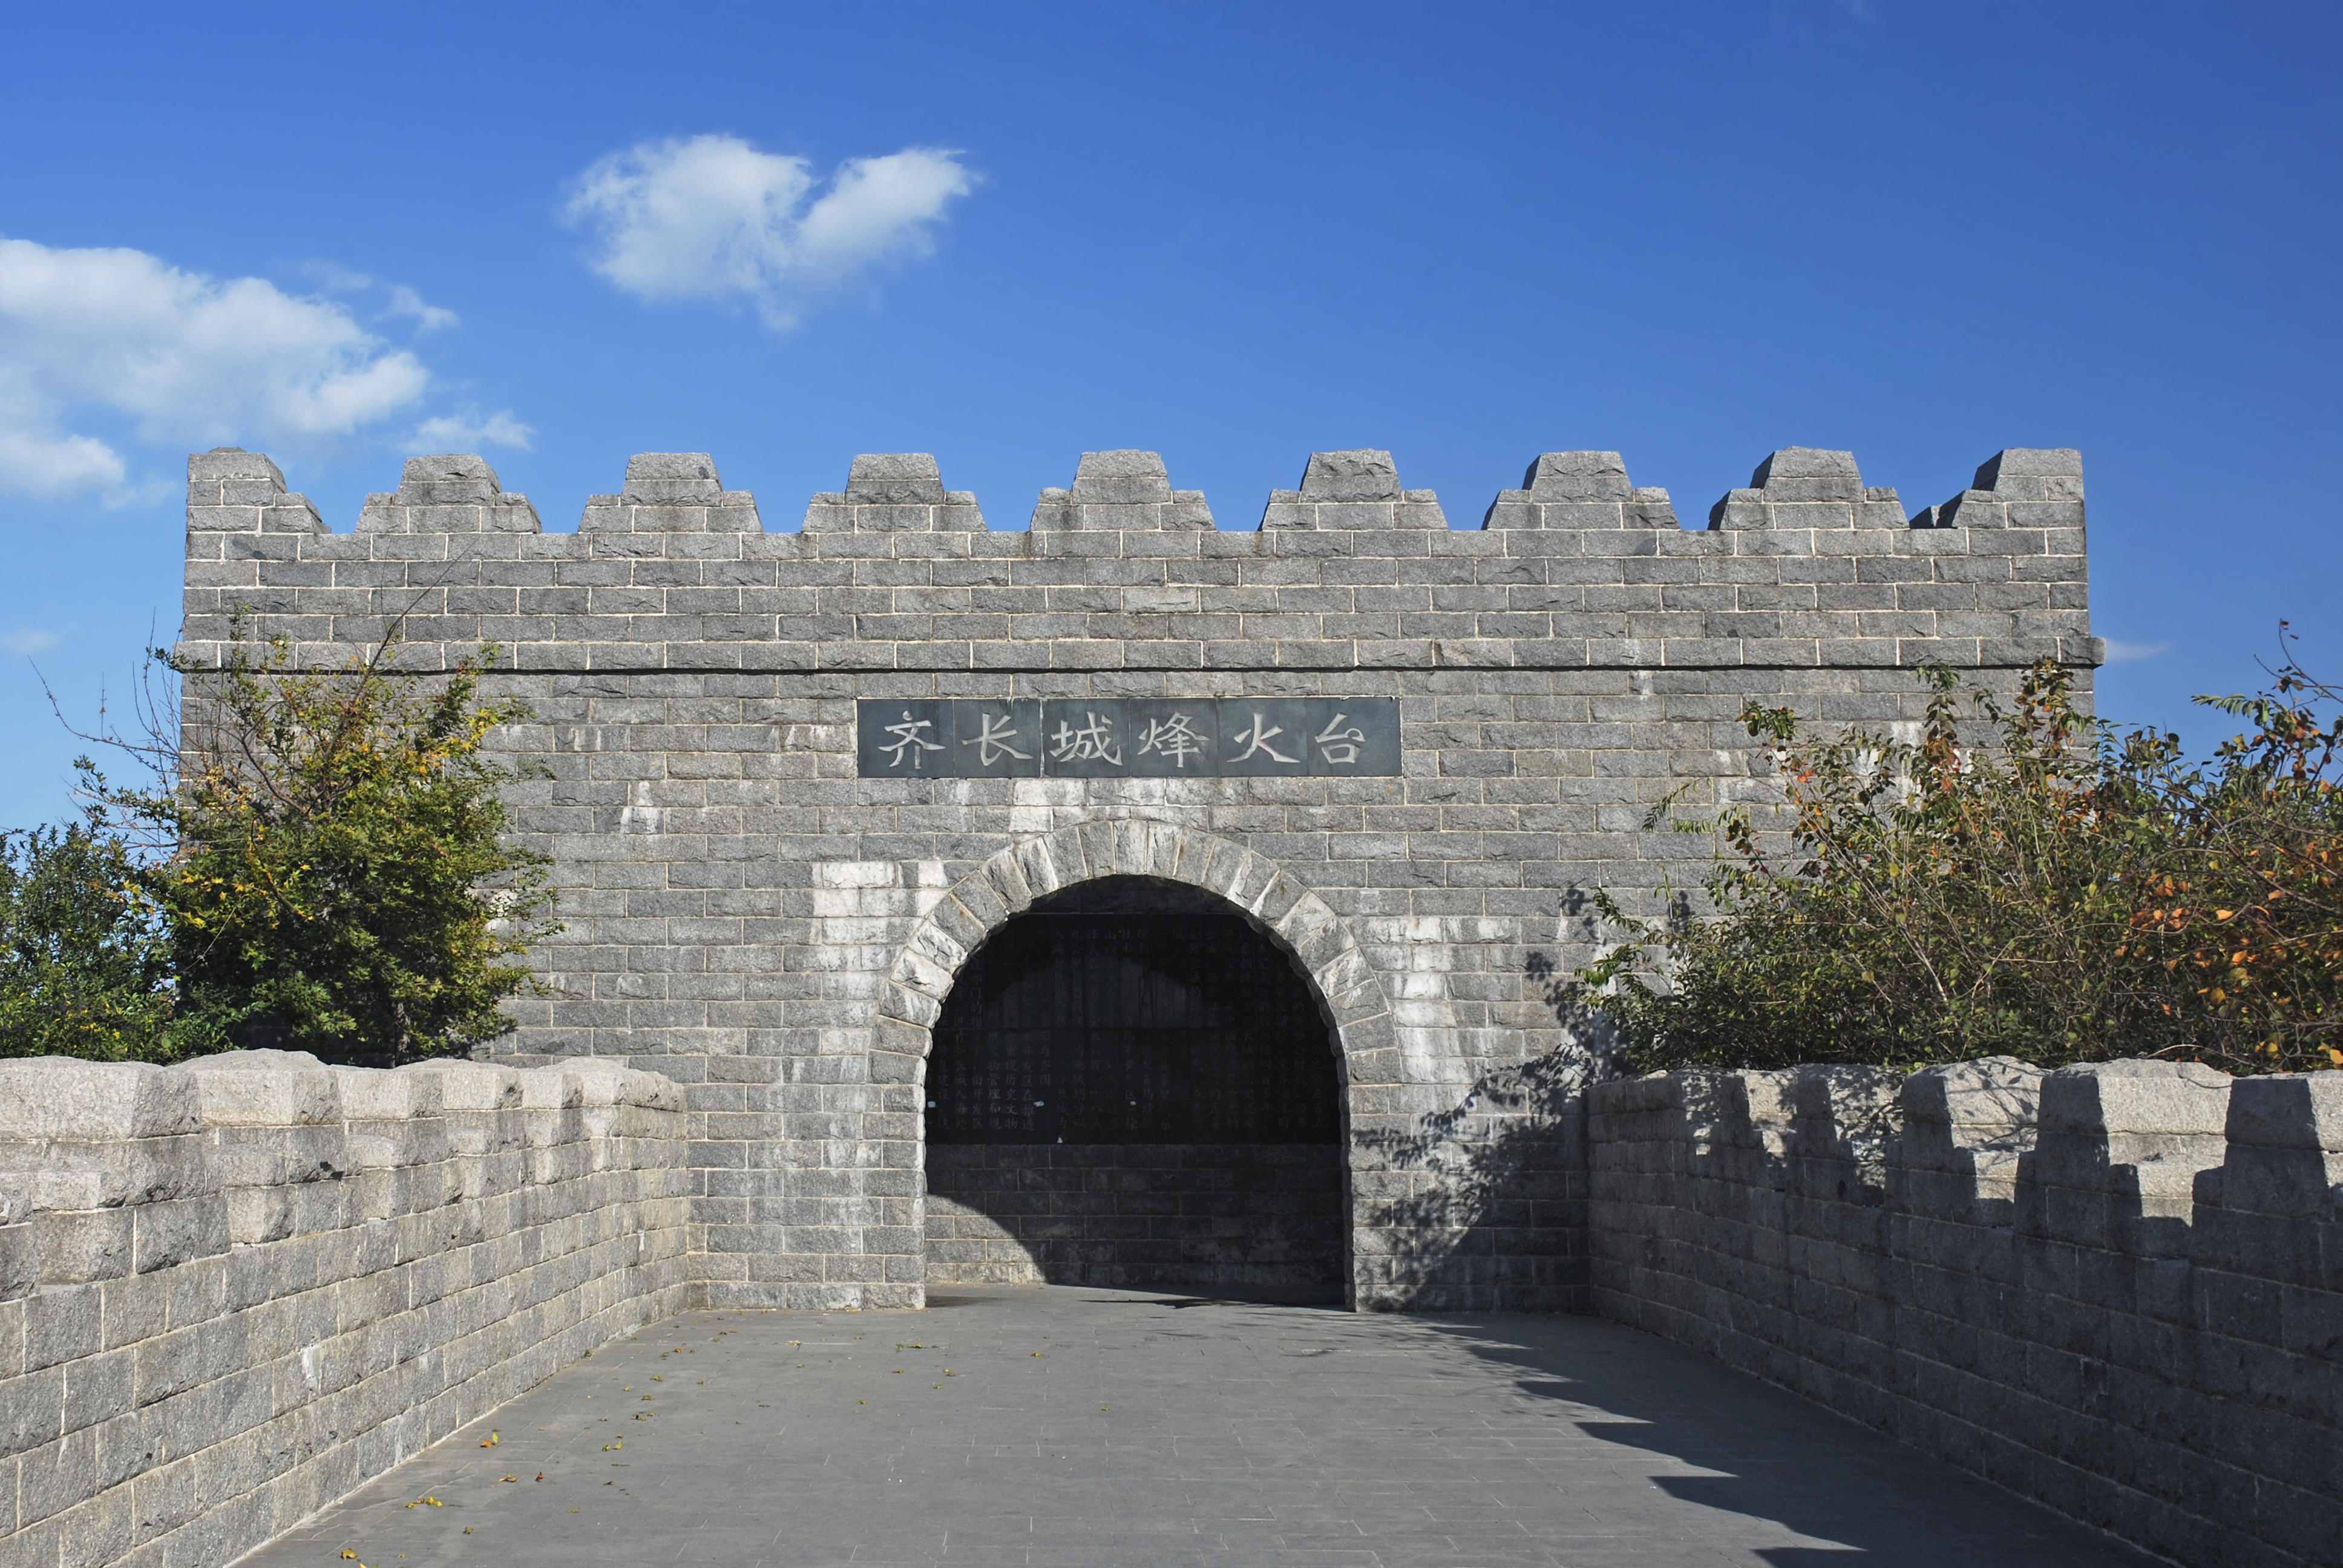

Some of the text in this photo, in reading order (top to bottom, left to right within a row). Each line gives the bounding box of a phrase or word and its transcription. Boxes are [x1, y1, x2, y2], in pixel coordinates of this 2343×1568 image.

[878, 710, 1366, 769] 齐长城烽火台
